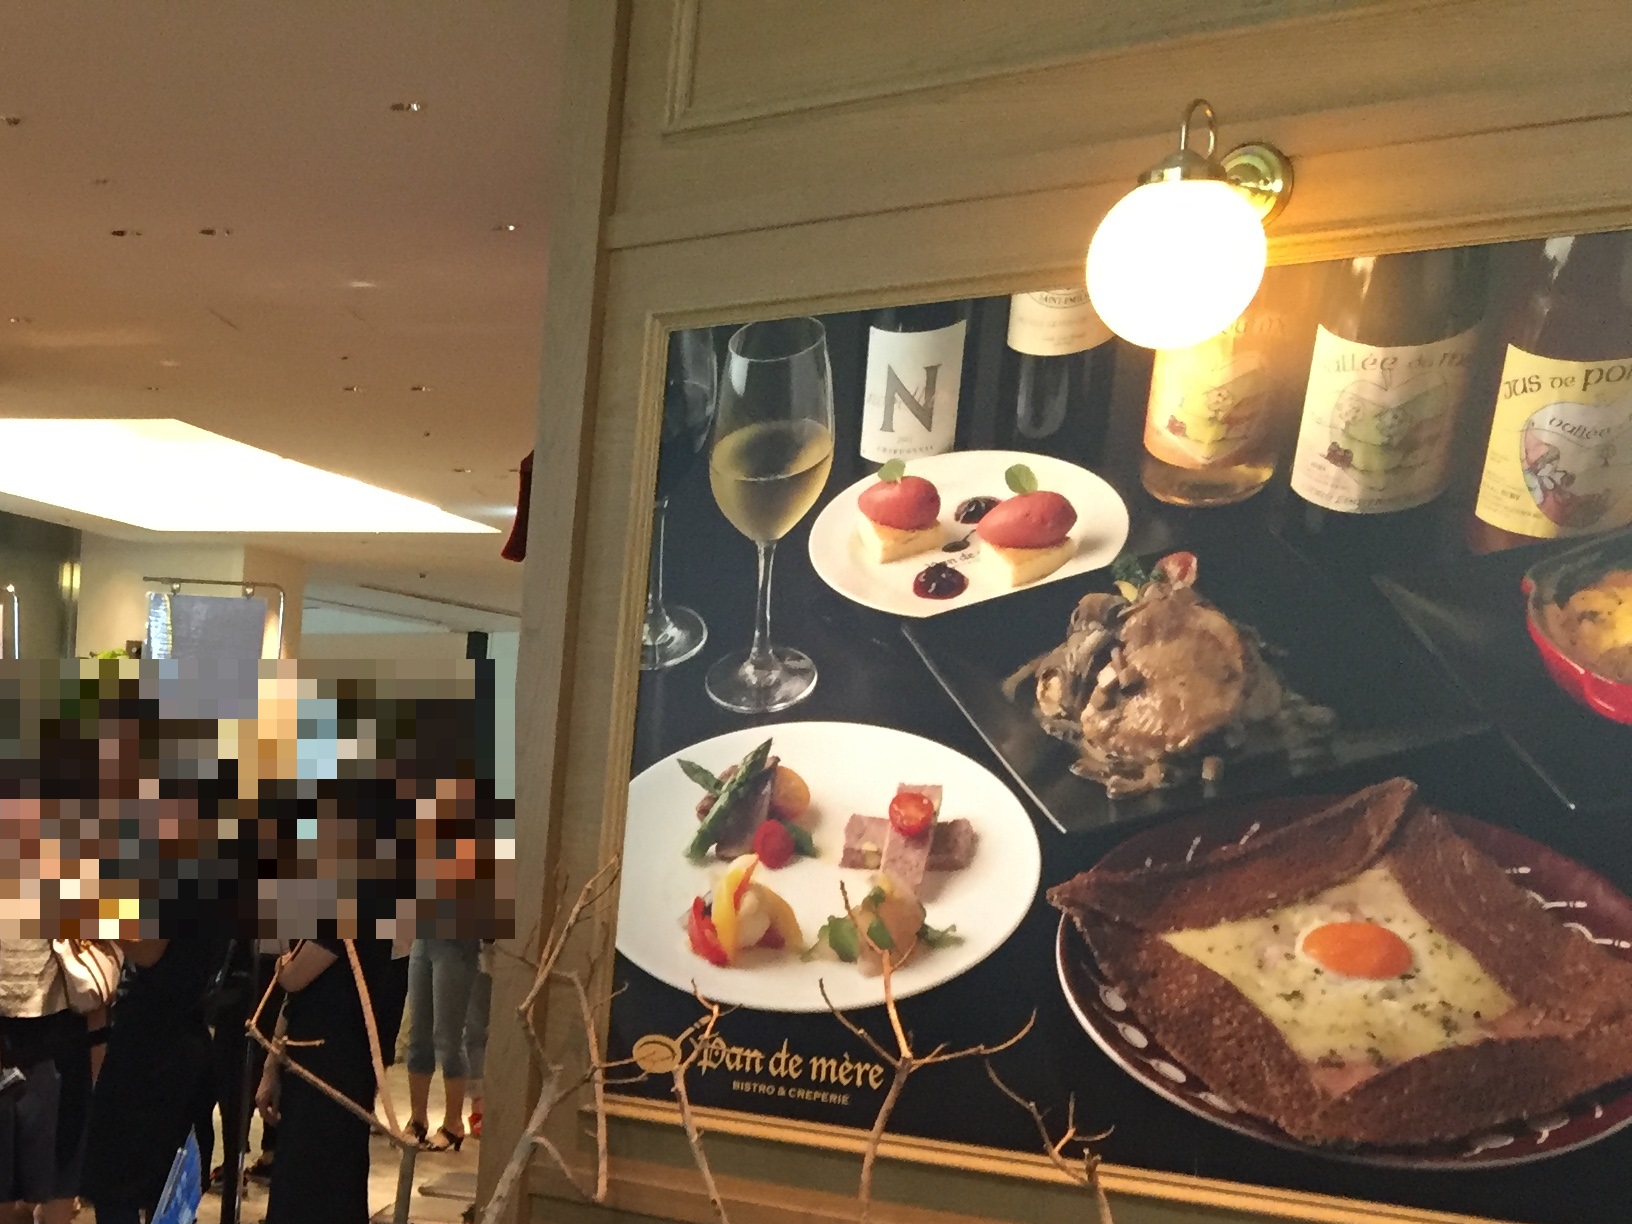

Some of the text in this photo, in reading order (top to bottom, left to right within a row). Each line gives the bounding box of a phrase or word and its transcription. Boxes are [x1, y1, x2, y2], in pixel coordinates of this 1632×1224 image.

[880, 364, 942, 432] N
[732, 1080, 776, 1096] BISTRO
[777, 1086, 786, 1097] &
[769, 1038, 804, 1079] de
[809, 1051, 885, 1091] mère
